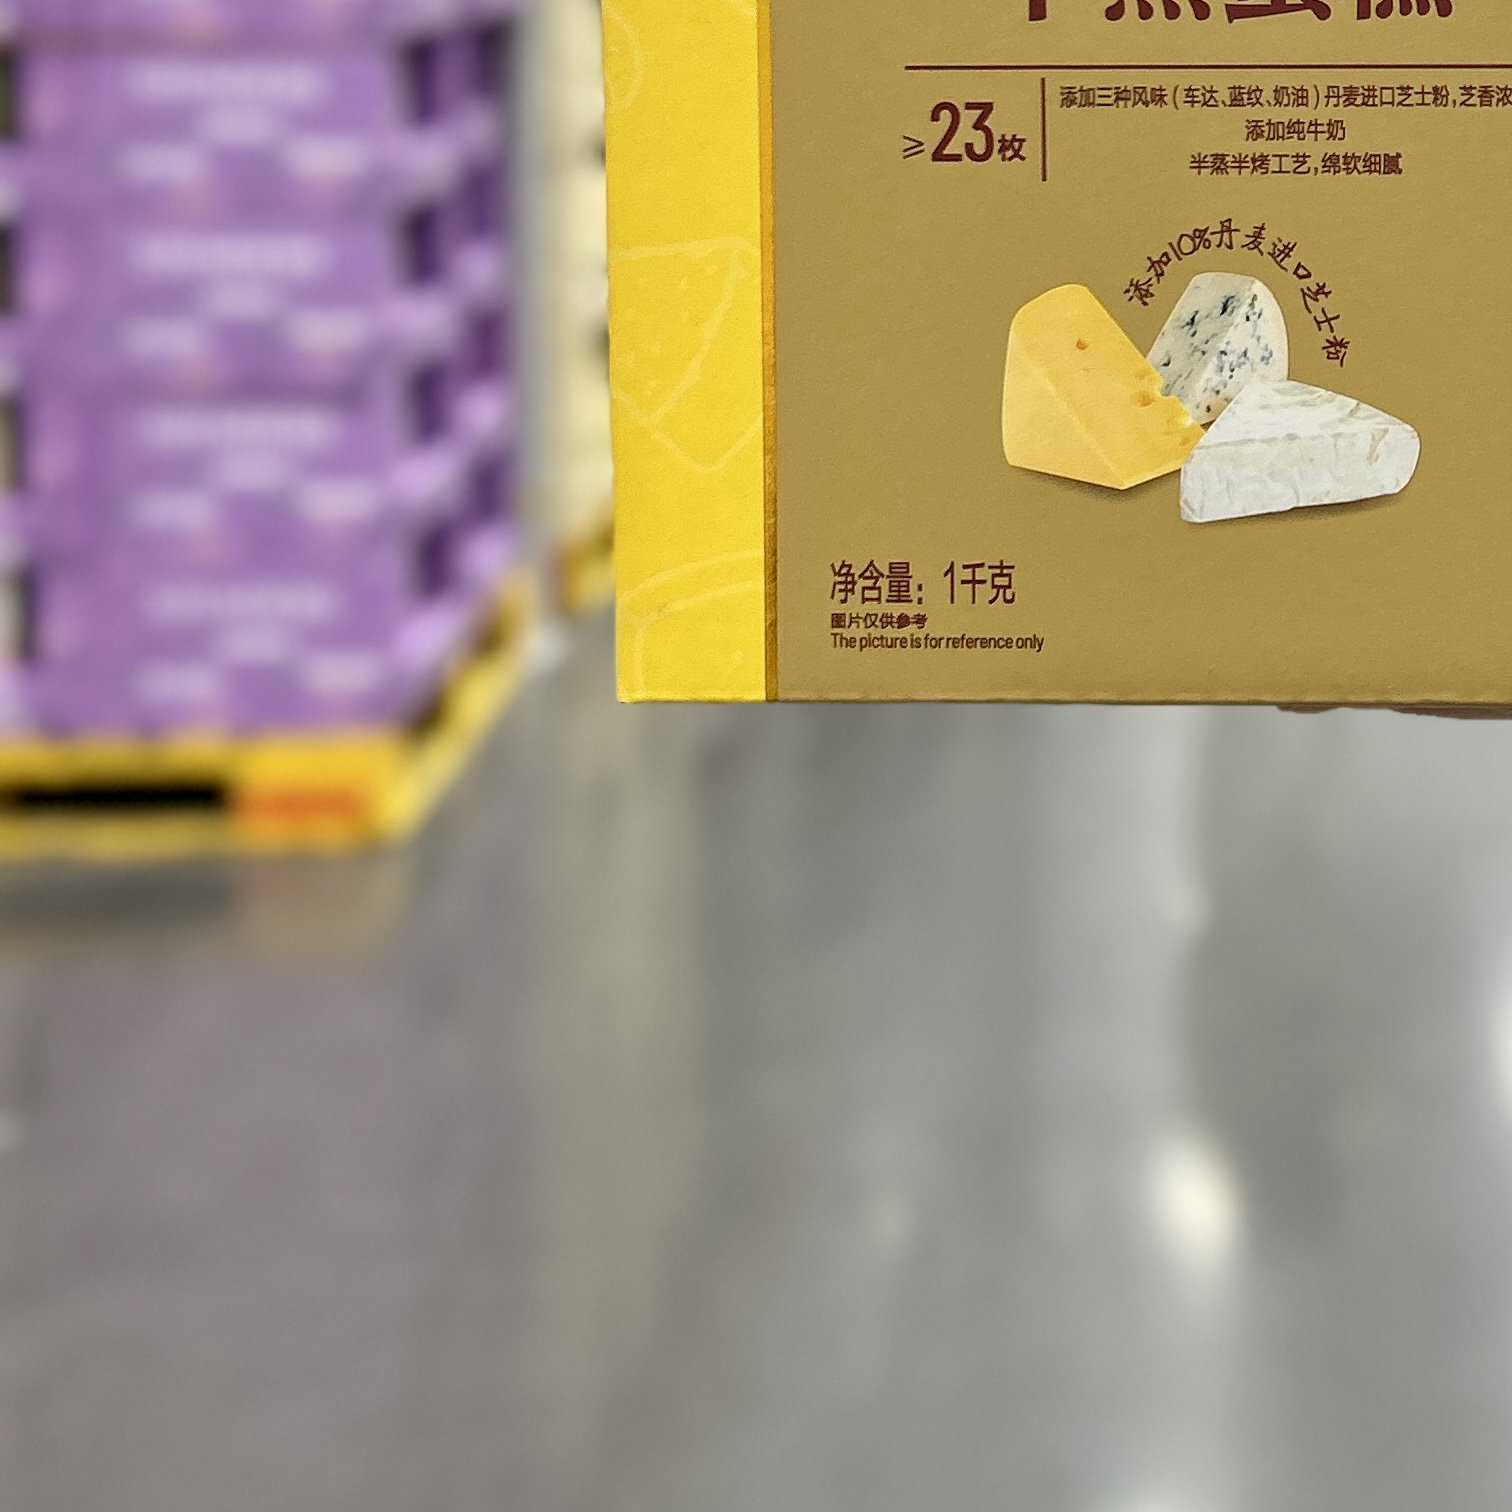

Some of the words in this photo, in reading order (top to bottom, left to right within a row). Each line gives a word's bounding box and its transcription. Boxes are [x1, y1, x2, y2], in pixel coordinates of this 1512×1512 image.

[1244, 118, 1347, 142] 添加纯牛奶
[1189, 152, 1404, 176] 半蒸半烤工艺，绵软细腻
[1123, 218, 1350, 368] 添加10%丹麦进口芝士粉
[830, 633, 857, 649] The
[859, 633, 909, 652] picture
[910, 633, 922, 649] is
[924, 633, 944, 649] for
[946, 634, 1013, 649] reference
[1016, 634, 1044, 652] only
